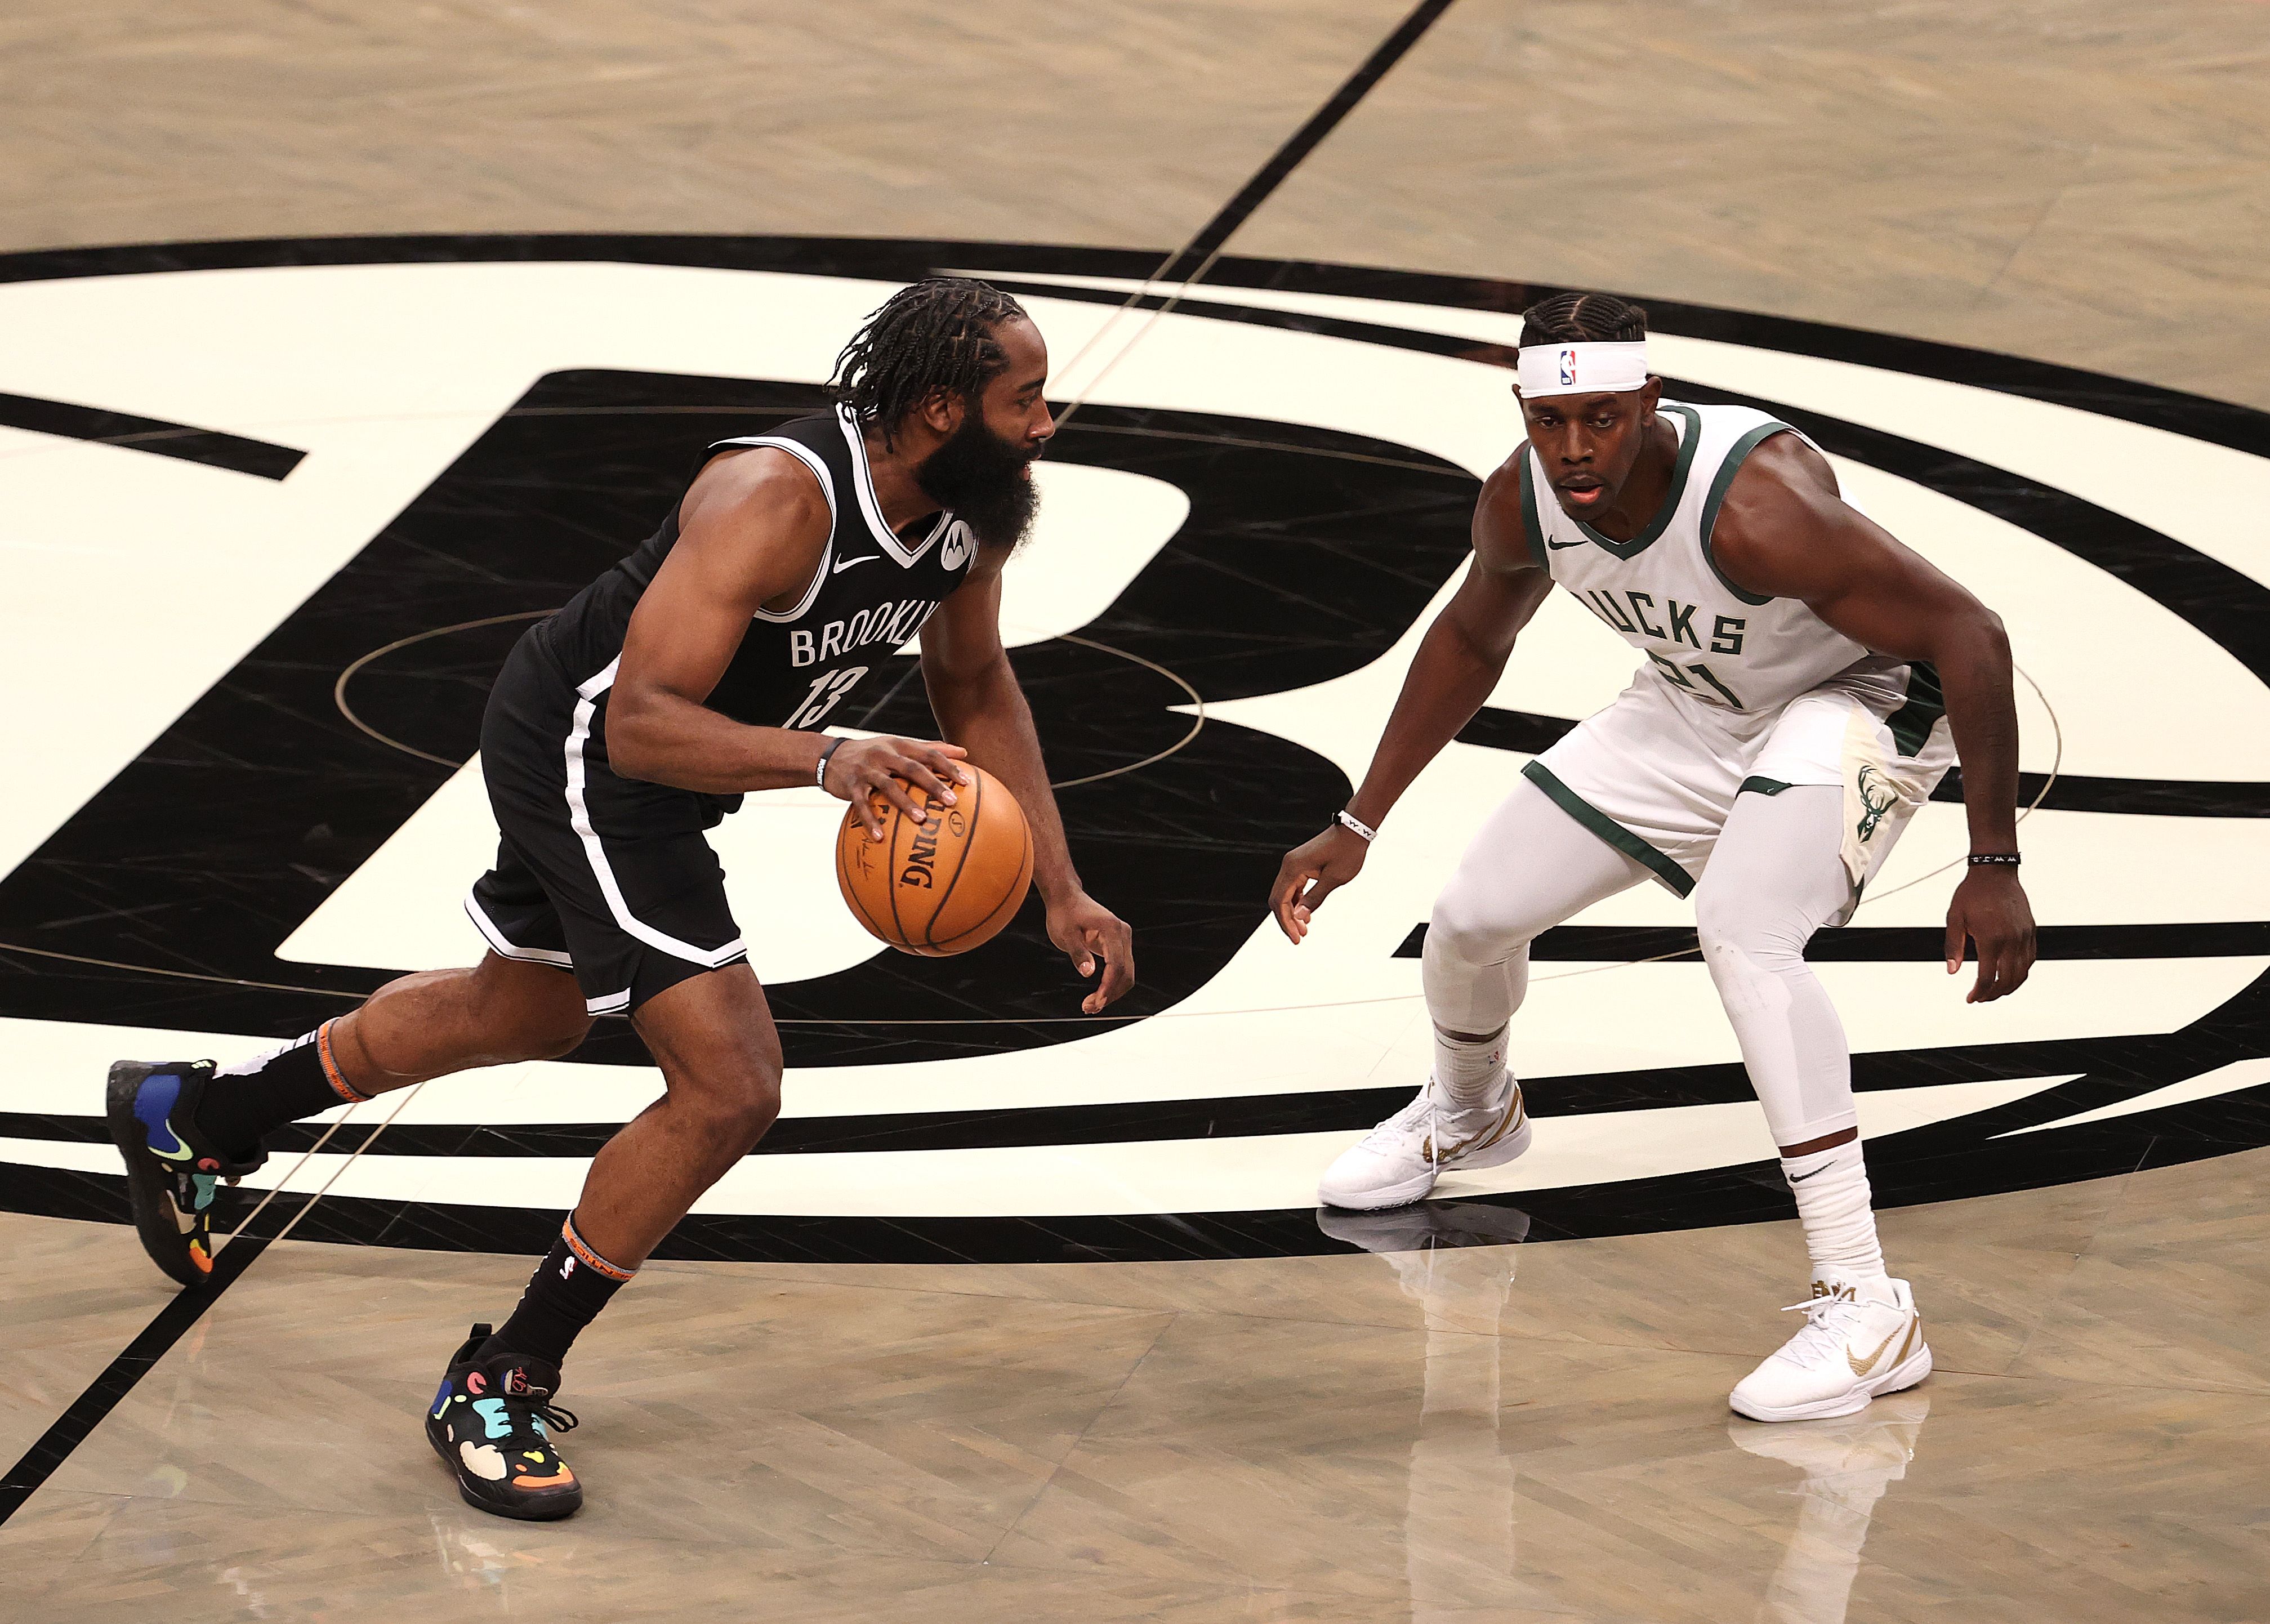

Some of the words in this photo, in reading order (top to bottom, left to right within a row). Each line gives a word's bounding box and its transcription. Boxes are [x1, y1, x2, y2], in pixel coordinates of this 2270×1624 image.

[790, 599, 940, 667] BROOKLY
[1570, 587, 1746, 655] UCKS
[781, 666, 869, 729] 13
